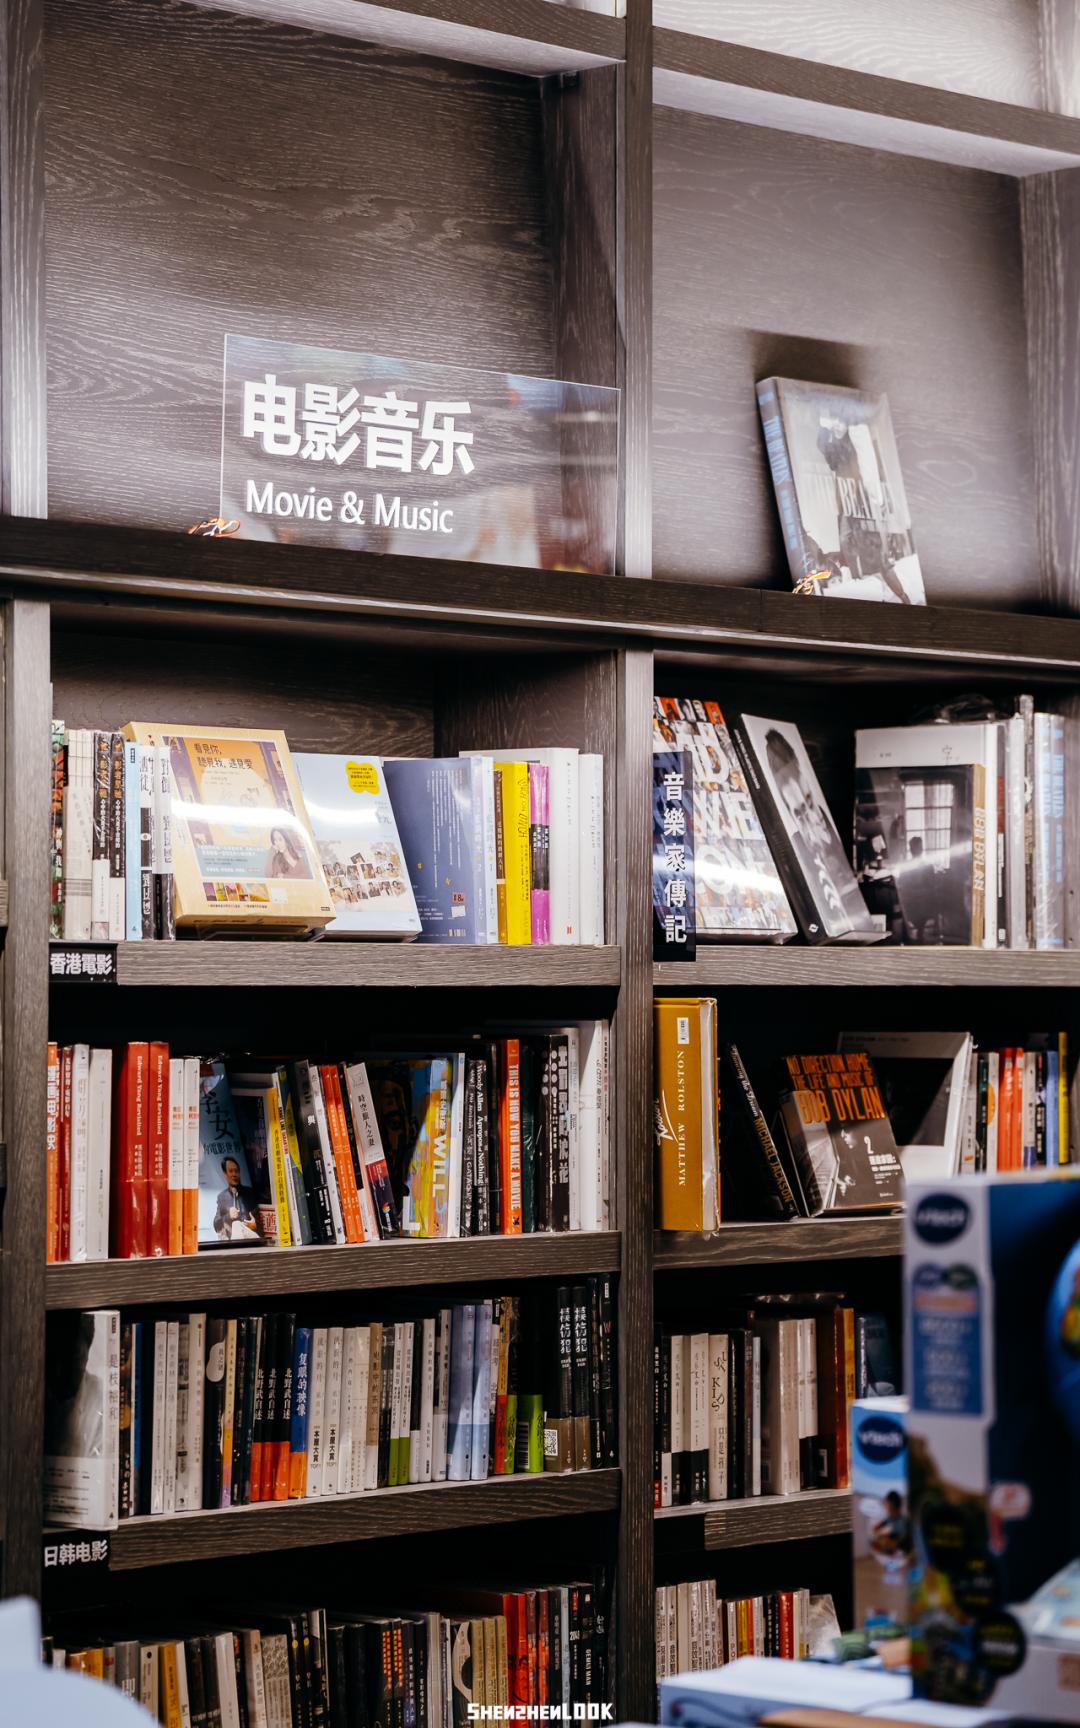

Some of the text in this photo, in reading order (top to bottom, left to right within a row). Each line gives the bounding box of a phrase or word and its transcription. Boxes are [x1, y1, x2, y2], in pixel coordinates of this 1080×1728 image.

[241, 374, 475, 476] 电影音乐
[246, 480, 454, 534] Movie & Music
[663, 770, 688, 944] 音樂家傳記
[50, 952, 113, 975] 香港電影
[477, 1064, 485, 1088] Woody
[508, 1064, 518, 1087] THIS
[509, 1088, 518, 1098] IS
[677, 1051, 686, 1186] MATTHEW ROLSTON
[796, 1087, 886, 1125] BOB DYLAN
[509, 1123, 519, 1144] YOU
[432, 1135, 446, 1198] WILL
[478, 1150, 486, 1184] Nothing
[754, 1116, 777, 1165] MICHAEL
[768, 1161, 794, 1204] JACKSON
[282, 1367, 292, 1420] 北野武自述
[44, 1540, 108, 1568] 日韩电影
